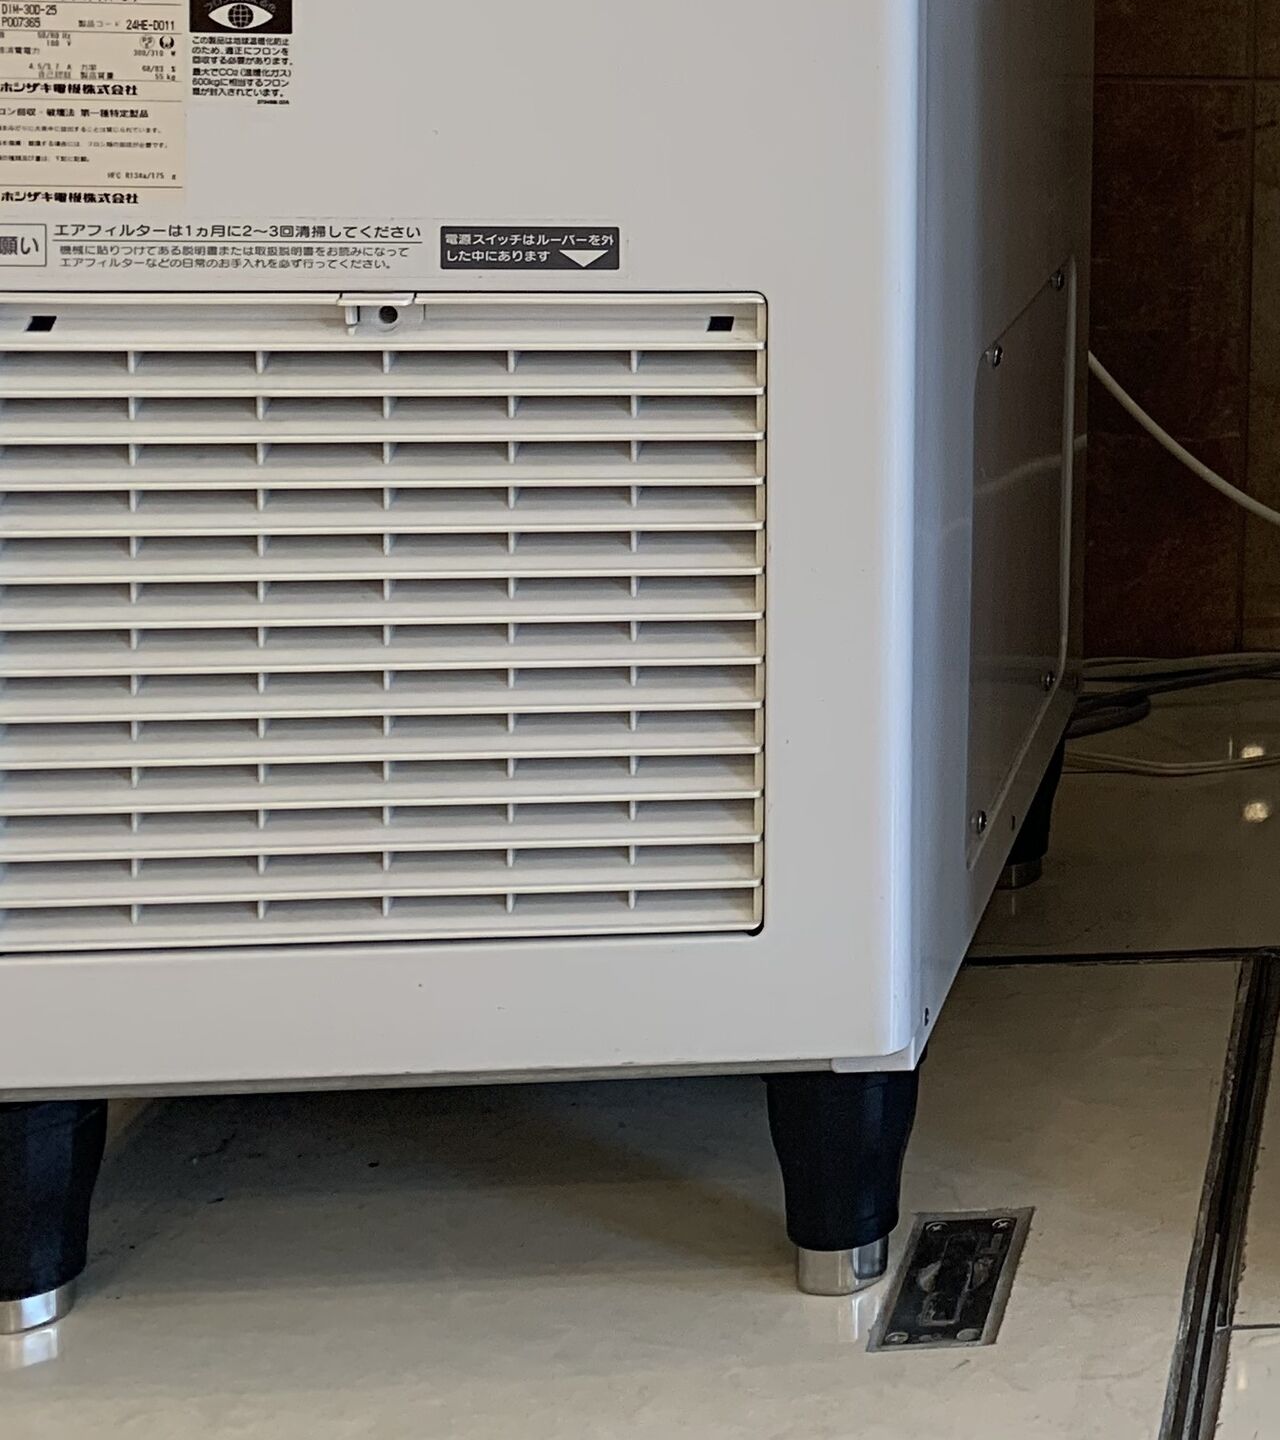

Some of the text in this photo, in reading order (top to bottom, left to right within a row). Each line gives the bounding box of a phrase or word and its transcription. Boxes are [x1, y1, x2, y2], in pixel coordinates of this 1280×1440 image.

[0, 82, 139, 96] ホシザキ電機株式会社
[1, 191, 139, 204] ホシザキ電機株式会社
[445, 233, 615, 246] 電源スイッチはルーバーを外
[446, 249, 551, 262] した中にあります
